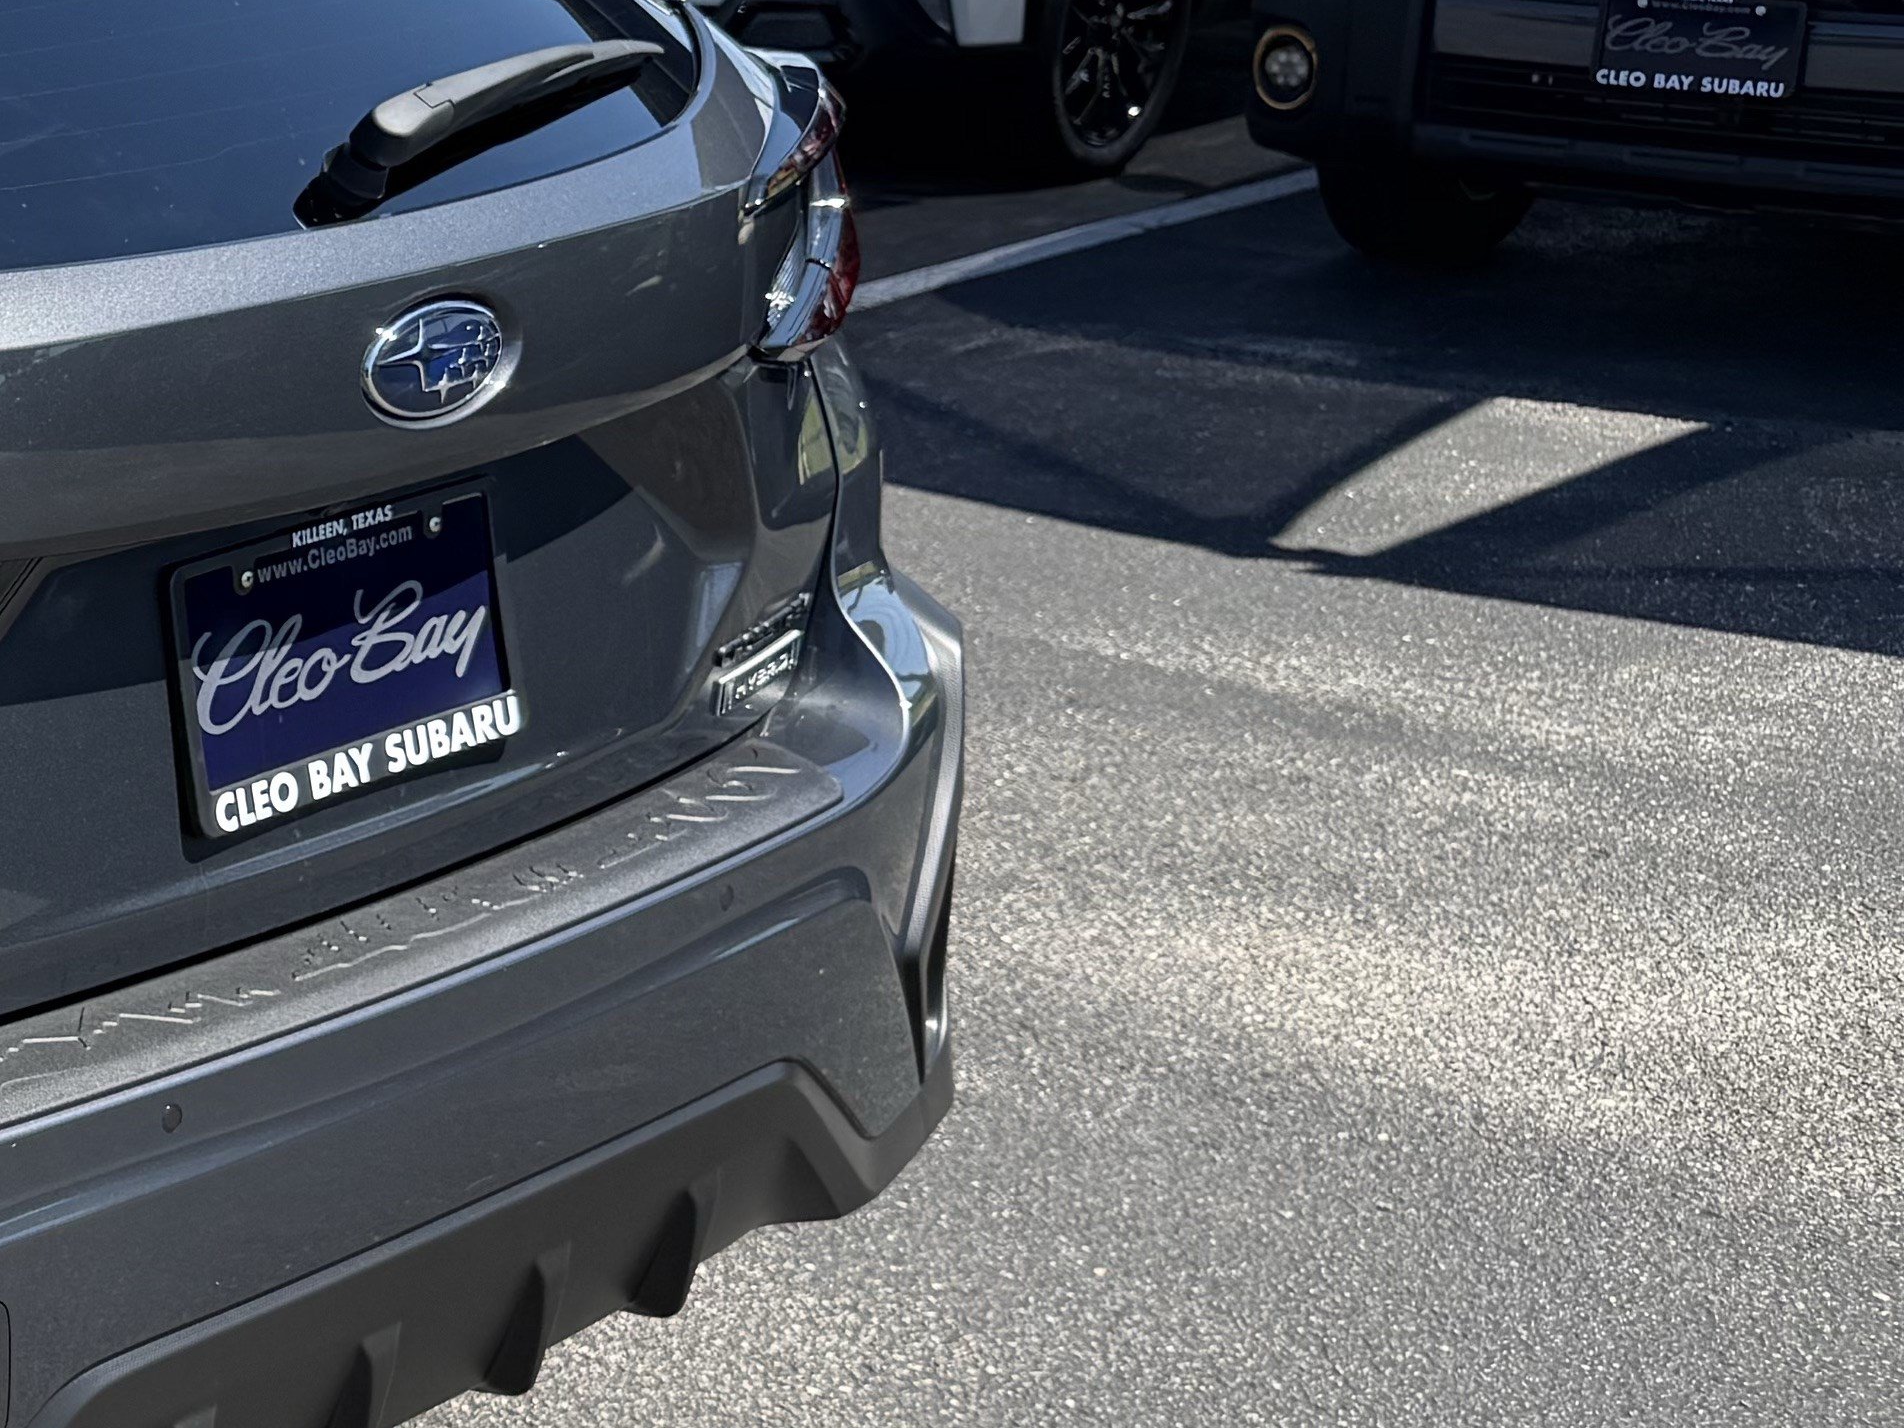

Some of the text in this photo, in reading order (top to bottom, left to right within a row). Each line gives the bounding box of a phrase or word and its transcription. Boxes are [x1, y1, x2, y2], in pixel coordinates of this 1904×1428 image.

[1595, 68, 1785, 98] CLEO BAY SUBARU
[256, 524, 413, 584] www.CleoBay.com
[292, 504, 393, 549] KILLEEN, TEXAS
[191, 579, 486, 736] Cleo Bay
[215, 694, 521, 833] CLEO BAY SUBARU
